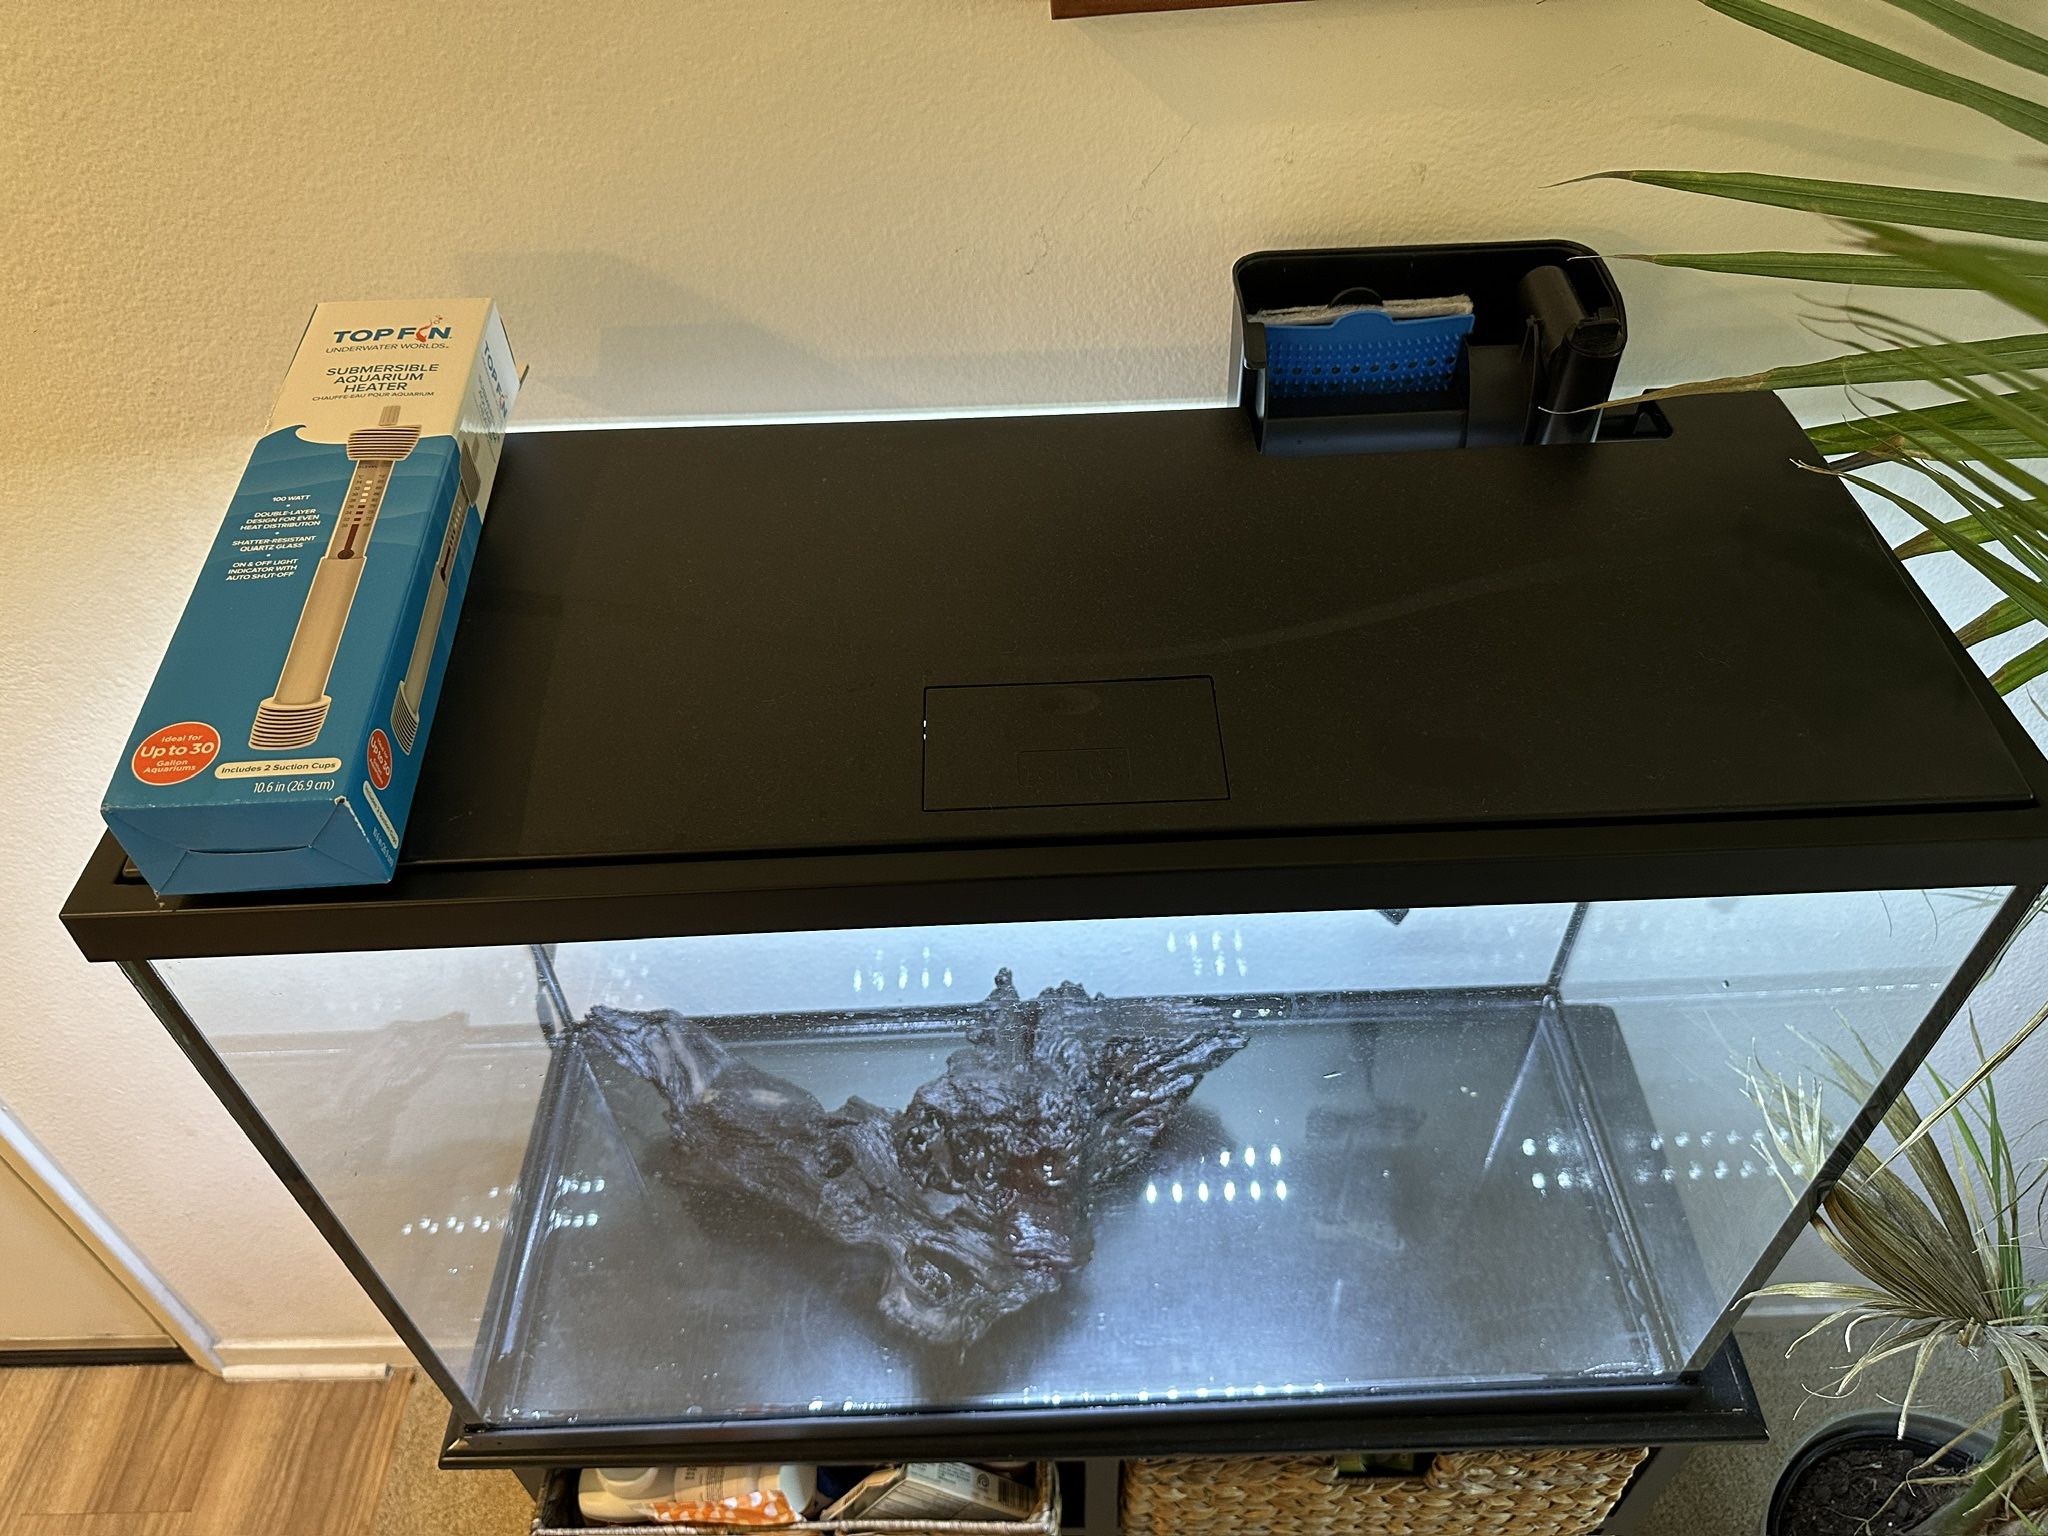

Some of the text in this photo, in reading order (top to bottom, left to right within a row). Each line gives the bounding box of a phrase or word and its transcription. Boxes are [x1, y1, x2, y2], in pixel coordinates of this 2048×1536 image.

[333, 328, 394, 343] TOP
[325, 343, 398, 353] UNDERWATER
[326, 364, 440, 376] SUBMERSIBLE
[334, 373, 424, 384] AQUARIUM
[344, 382, 408, 393] HEATER
[254, 508, 316, 518] DOUBLE-LAYER
[263, 520, 321, 530] DISTRIBUTION
[232, 536, 317, 546] SHATTER-RESISTANT
[228, 566, 275, 574] INDICATOR
[162, 734, 186, 743] Ideal
[140, 742, 215, 758] Up to 30
[156, 758, 188, 767] Gallon
[221, 761, 336, 774] Includes 2 Suction Cups
[144, 764, 196, 774] Aquariums
[253, 779, 335, 794] 10.6 in (26.9 cm)
